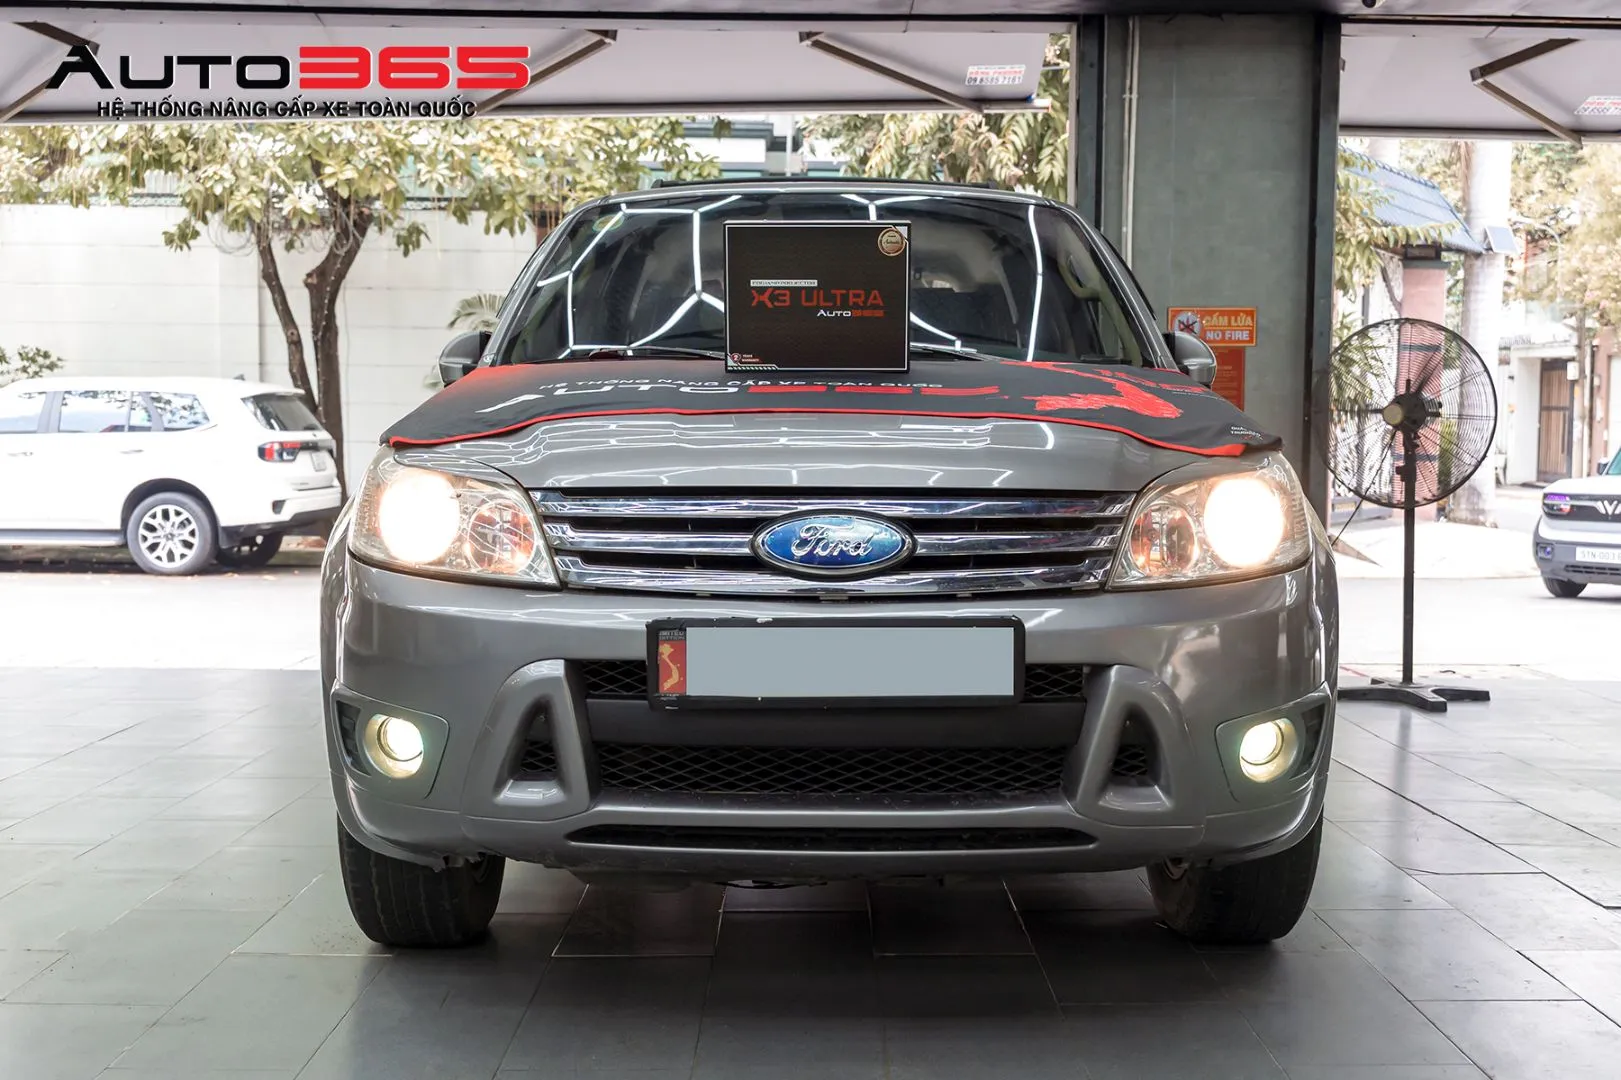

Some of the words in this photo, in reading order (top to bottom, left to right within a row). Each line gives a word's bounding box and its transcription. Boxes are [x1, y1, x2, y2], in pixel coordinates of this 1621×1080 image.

[751, 288, 791, 308] X3
[801, 289, 884, 306] ULTRA
[1206, 330, 1222, 340] NO
[1225, 330, 1250, 340] FIRE
[791, 523, 876, 556] Ford
